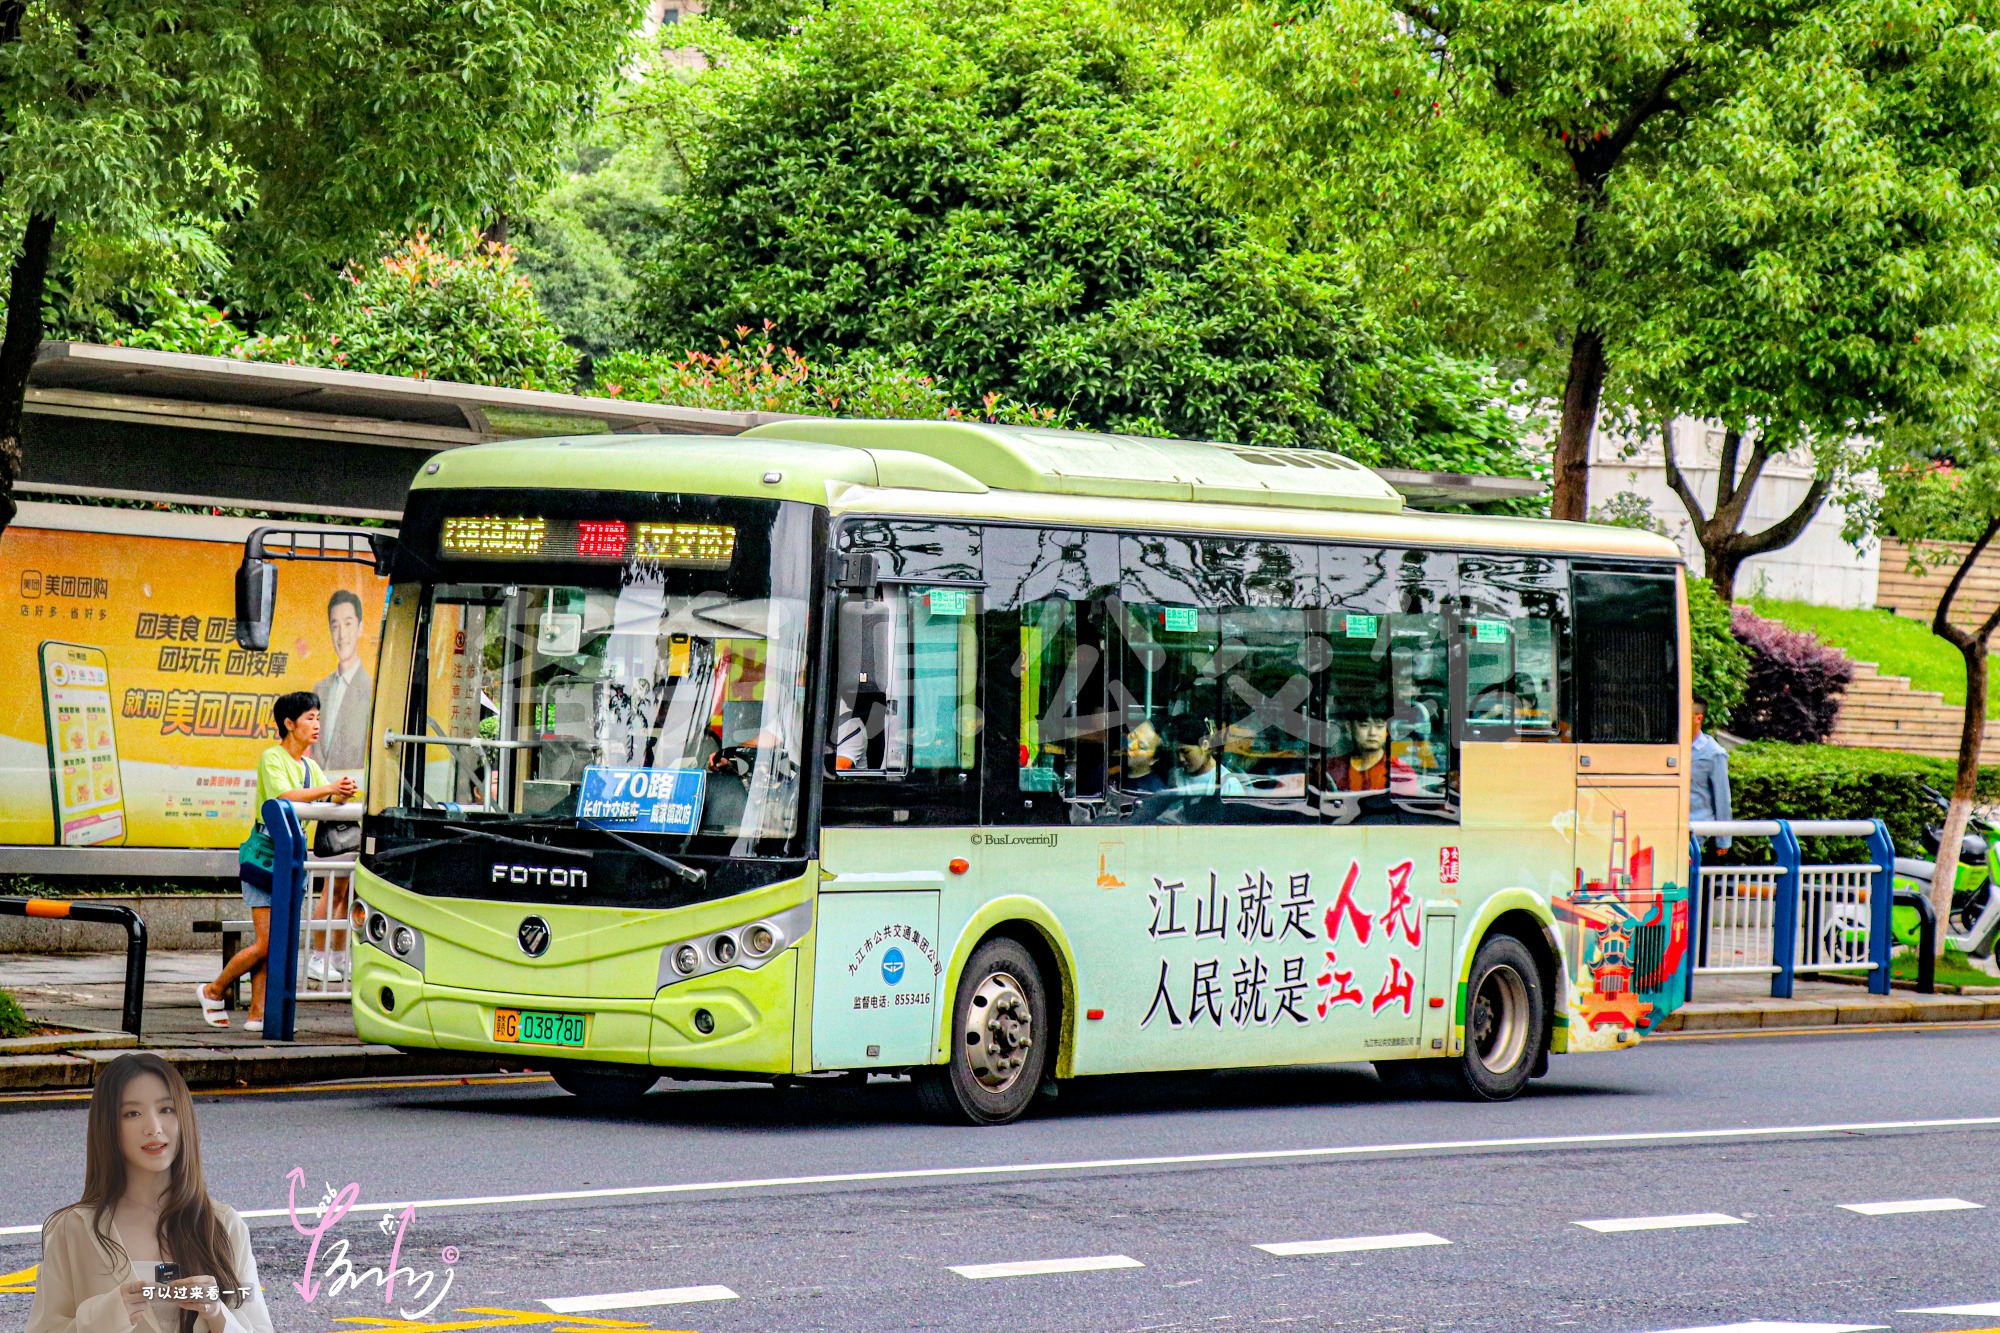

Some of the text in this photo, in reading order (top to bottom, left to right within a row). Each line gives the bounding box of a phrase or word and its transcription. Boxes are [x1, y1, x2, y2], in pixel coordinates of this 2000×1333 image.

[45, 575, 108, 599] 美团团购
[135, 612, 201, 642] 团美食
[158, 646, 288, 677] 团玩乐 团按摩
[613, 772, 674, 800] 70路
[492, 864, 588, 888] FOTON
[1148, 858, 1422, 948] 江山就是人民
[848, 923, 943, 977] 九江市公共交通集团公司
[895, 993, 930, 1006] 8553416
[1140, 951, 1416, 1028] 人民就是江山
